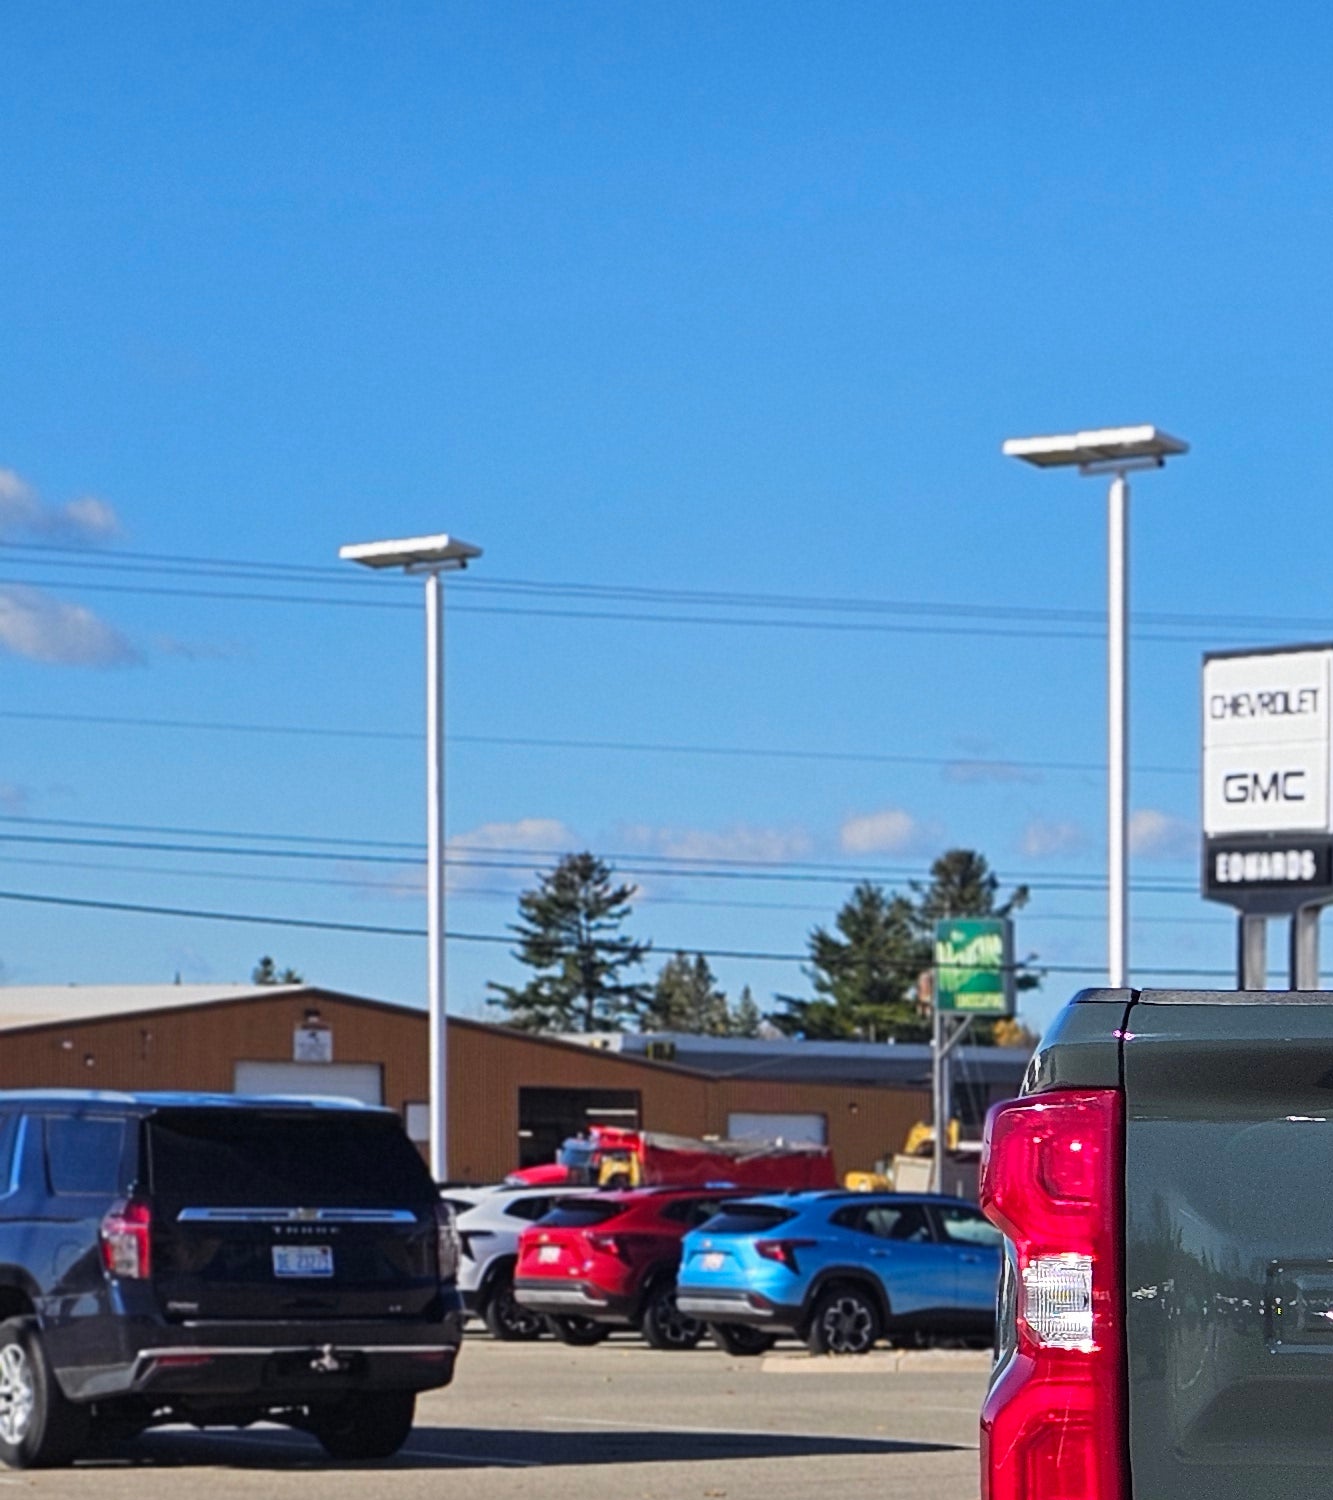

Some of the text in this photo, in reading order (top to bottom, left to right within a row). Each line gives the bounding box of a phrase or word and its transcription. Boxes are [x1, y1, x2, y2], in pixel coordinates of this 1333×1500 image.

[1210, 688, 1319, 720] CHEVROLET
[1223, 771, 1305, 803] GMC
[1214, 849, 1317, 883] EDWARDS
